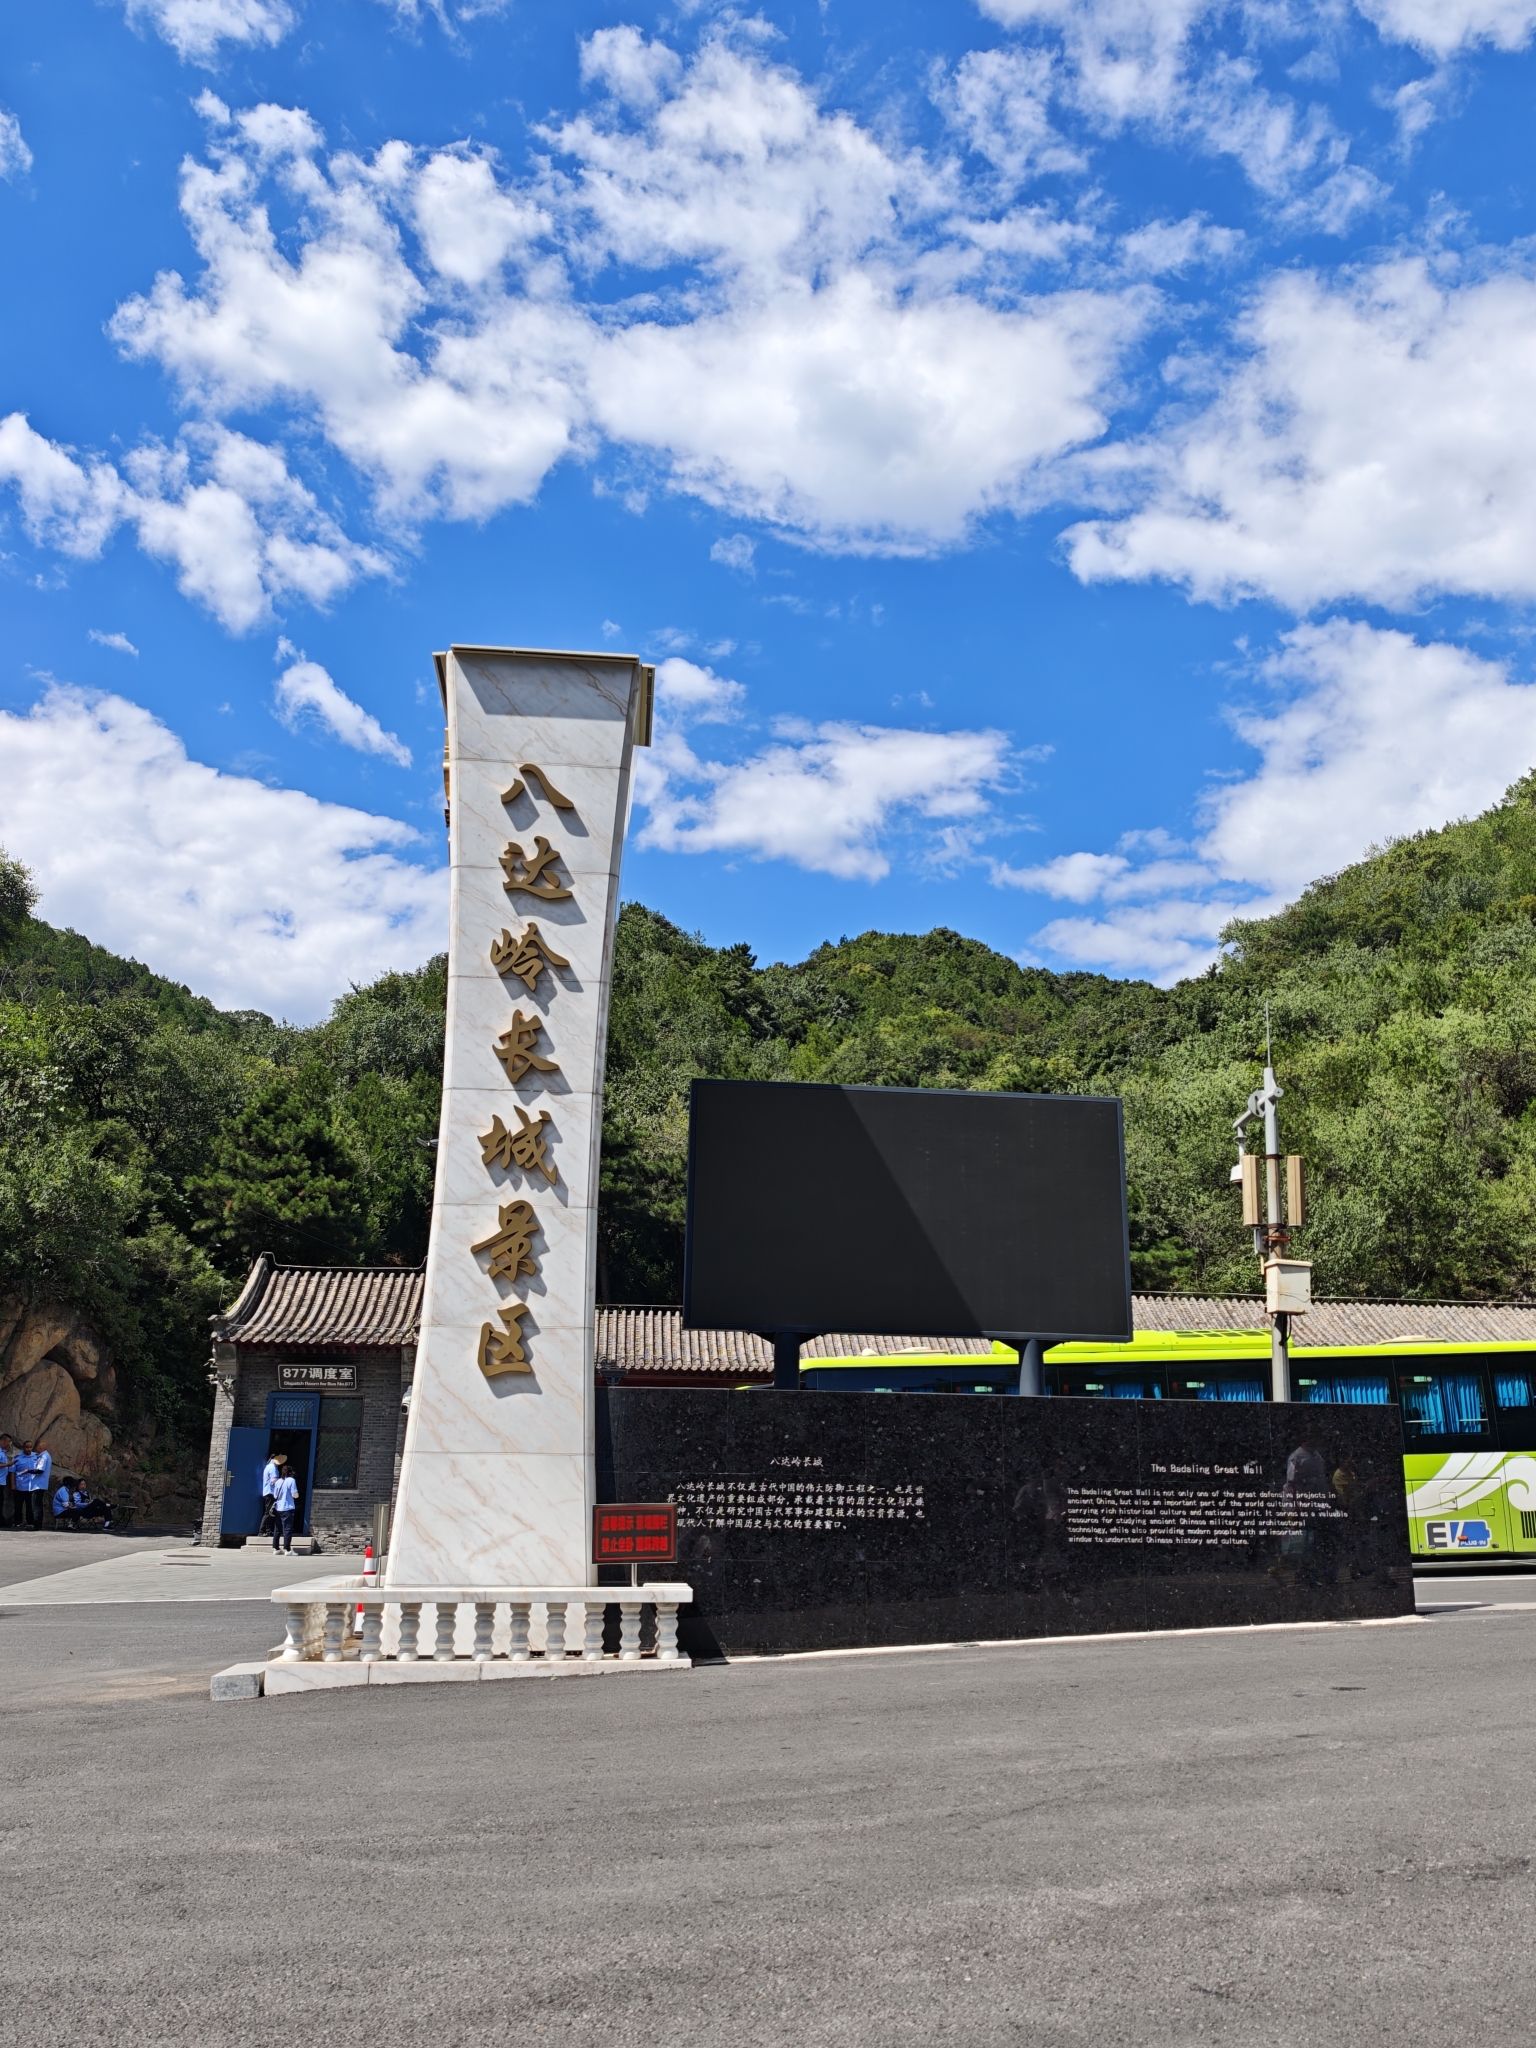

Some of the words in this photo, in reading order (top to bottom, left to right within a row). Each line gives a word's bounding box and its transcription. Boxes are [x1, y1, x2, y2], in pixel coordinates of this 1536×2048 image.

[470, 763, 574, 1379] 八达岭长城景区
[283, 1367, 353, 1380] 877调度室
[770, 1456, 823, 1467] 八达岭长城
[1151, 1464, 1166, 1472] The
[1170, 1464, 1210, 1474] Badaling
[1214, 1465, 1238, 1474] Great
[1243, 1465, 1262, 1474] Wall
[1082, 1488, 1111, 1496] Badaling
[1114, 1488, 1133, 1496] Great
[1178, 1490, 1193, 1498] only
[1096, 1498, 1117, 1506] China,
[1164, 1499, 1196, 1507] important
[677, 1506, 925, 1519] 神，不仅是研究中国古代军事和建筑技术的宝贵资源，也
[676, 1518, 847, 1530] 现代人了解中国历史与文化的重要窗口。
